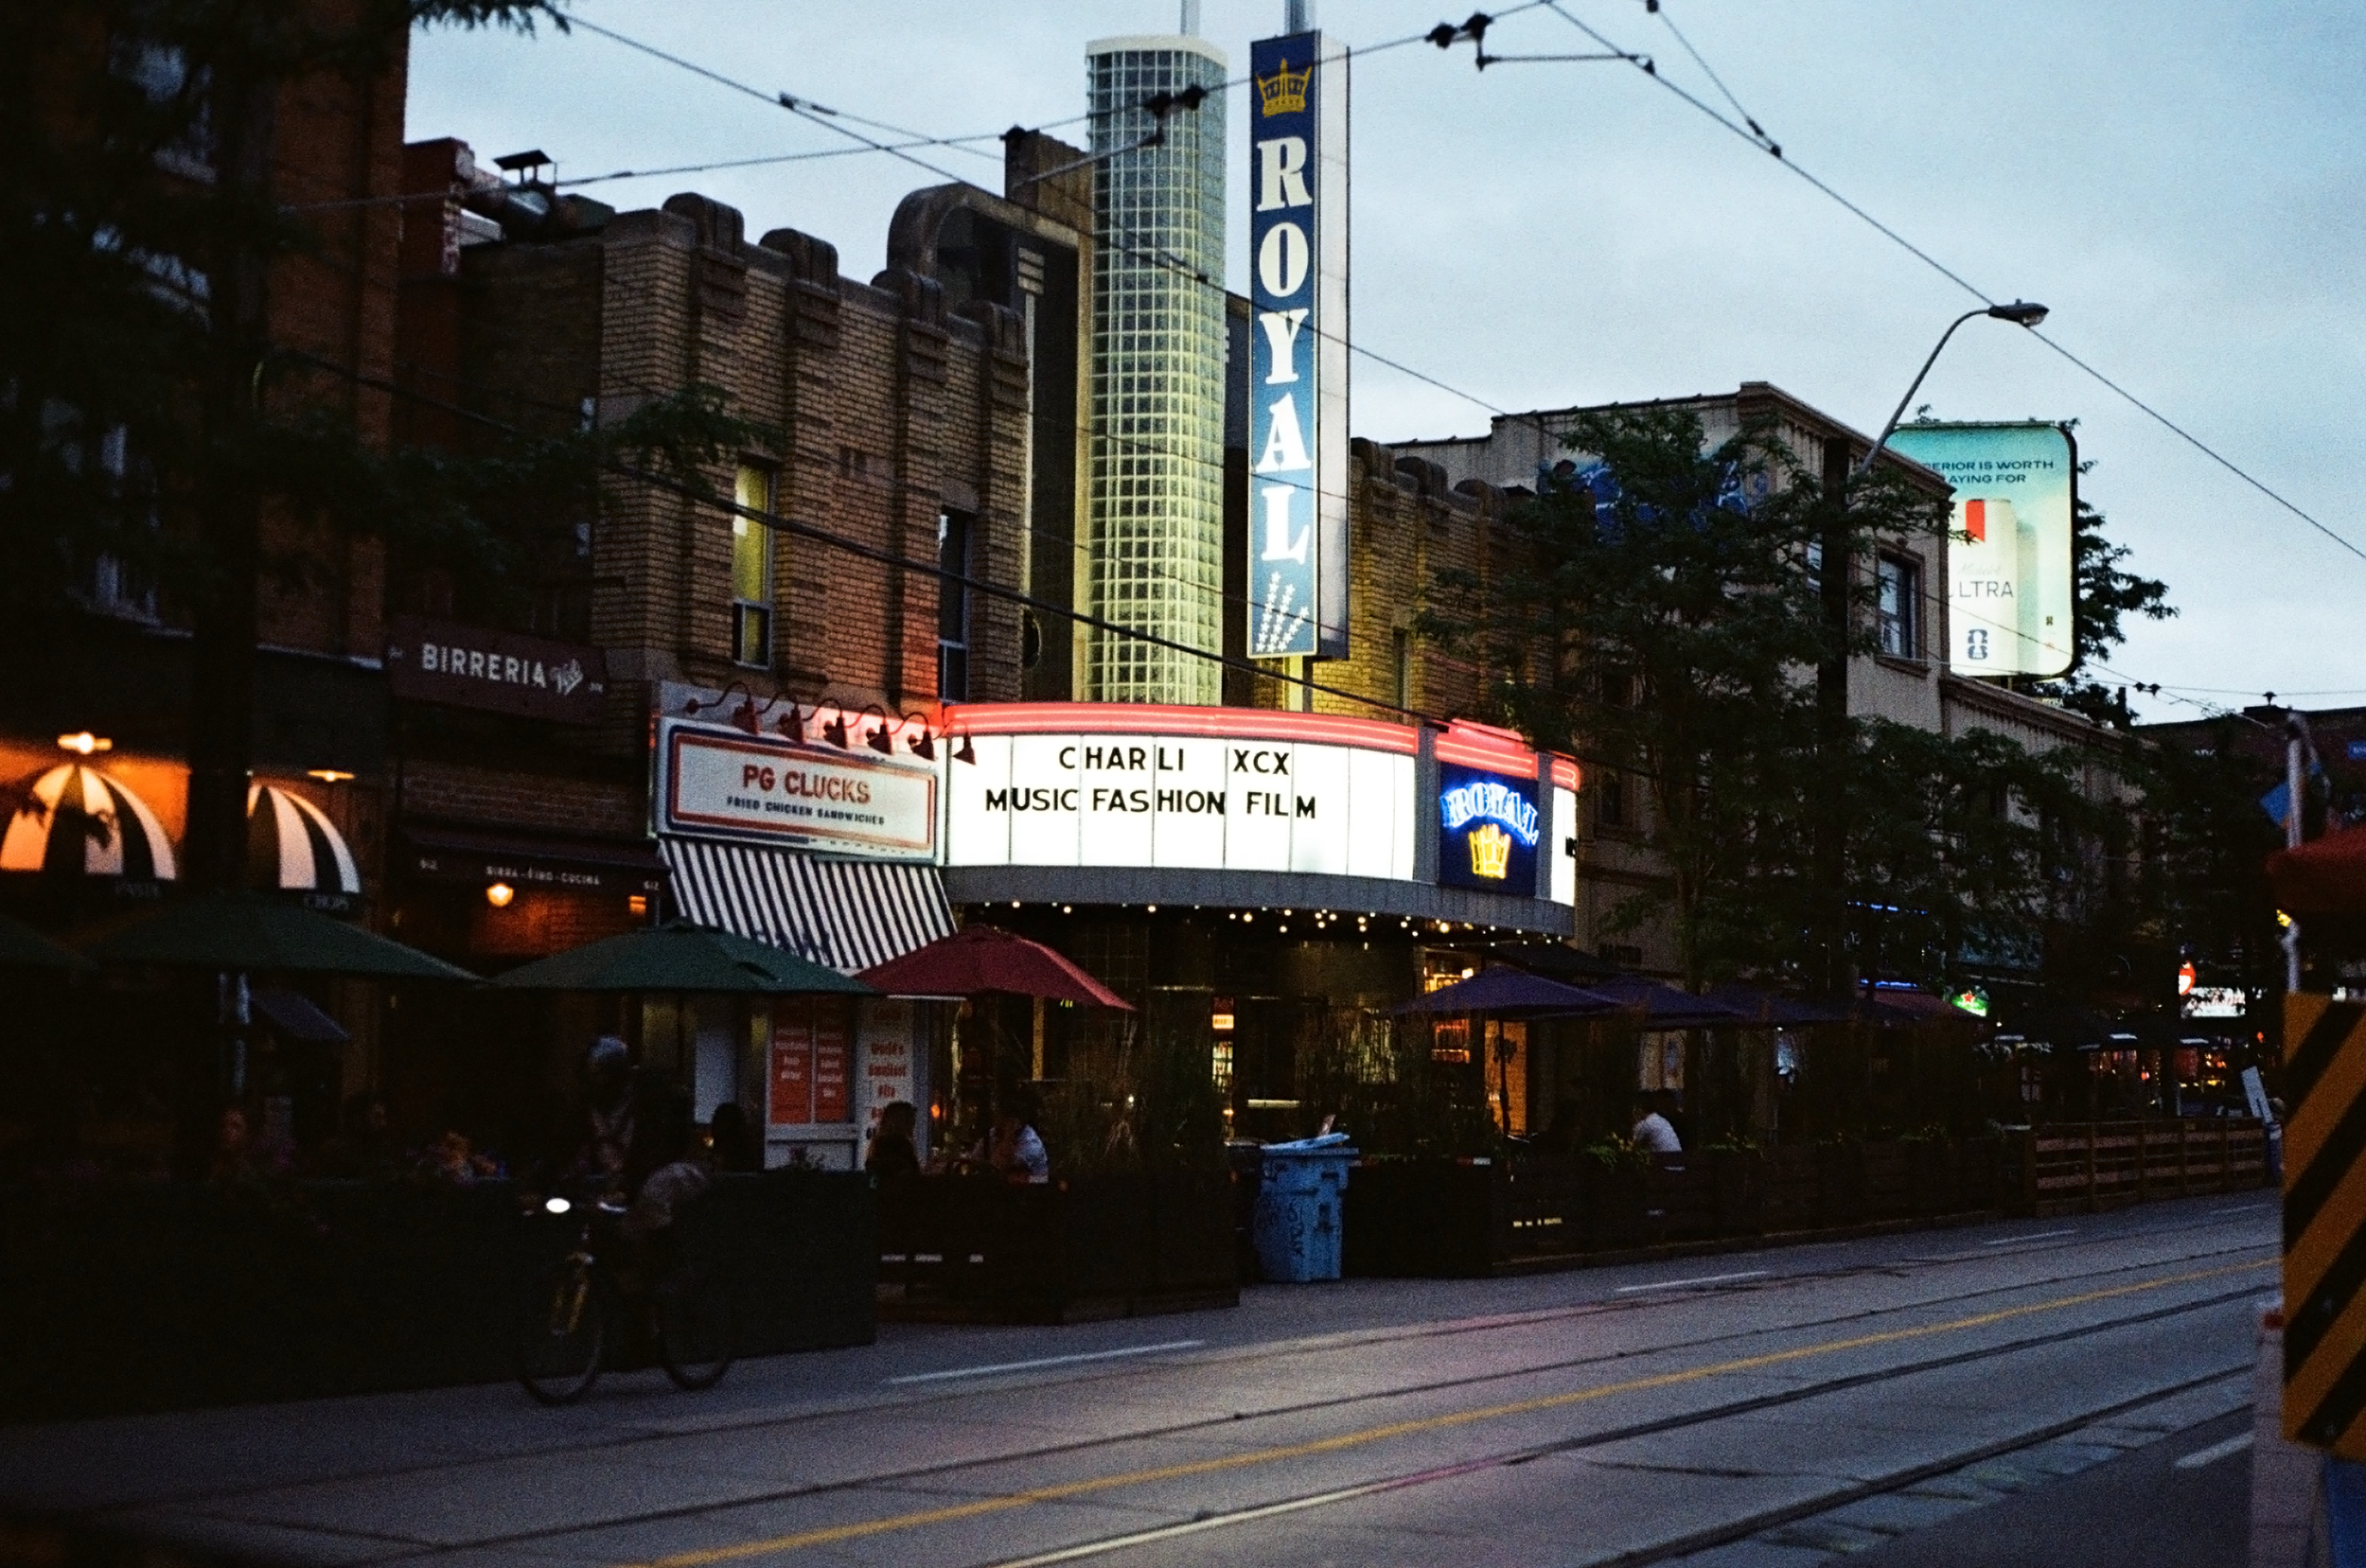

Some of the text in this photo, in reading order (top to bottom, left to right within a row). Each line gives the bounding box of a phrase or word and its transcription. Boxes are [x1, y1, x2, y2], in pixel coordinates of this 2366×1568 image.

[1256, 135, 1314, 566] ROYAL
[1949, 473, 2027, 484] AYING FOR
[1979, 461, 1993, 470] IS
[1996, 460, 2055, 470] WORTH
[422, 643, 548, 689] BIRRERIA
[1058, 746, 1291, 776] CHARLI XCX
[743, 763, 872, 805] PG CLUCKS
[726, 795, 886, 826] FRIED CHICKEN SANDWICHES
[985, 787, 1316, 819] MUSIC FASHION FILM
[1439, 782, 1540, 846] ROYAL
